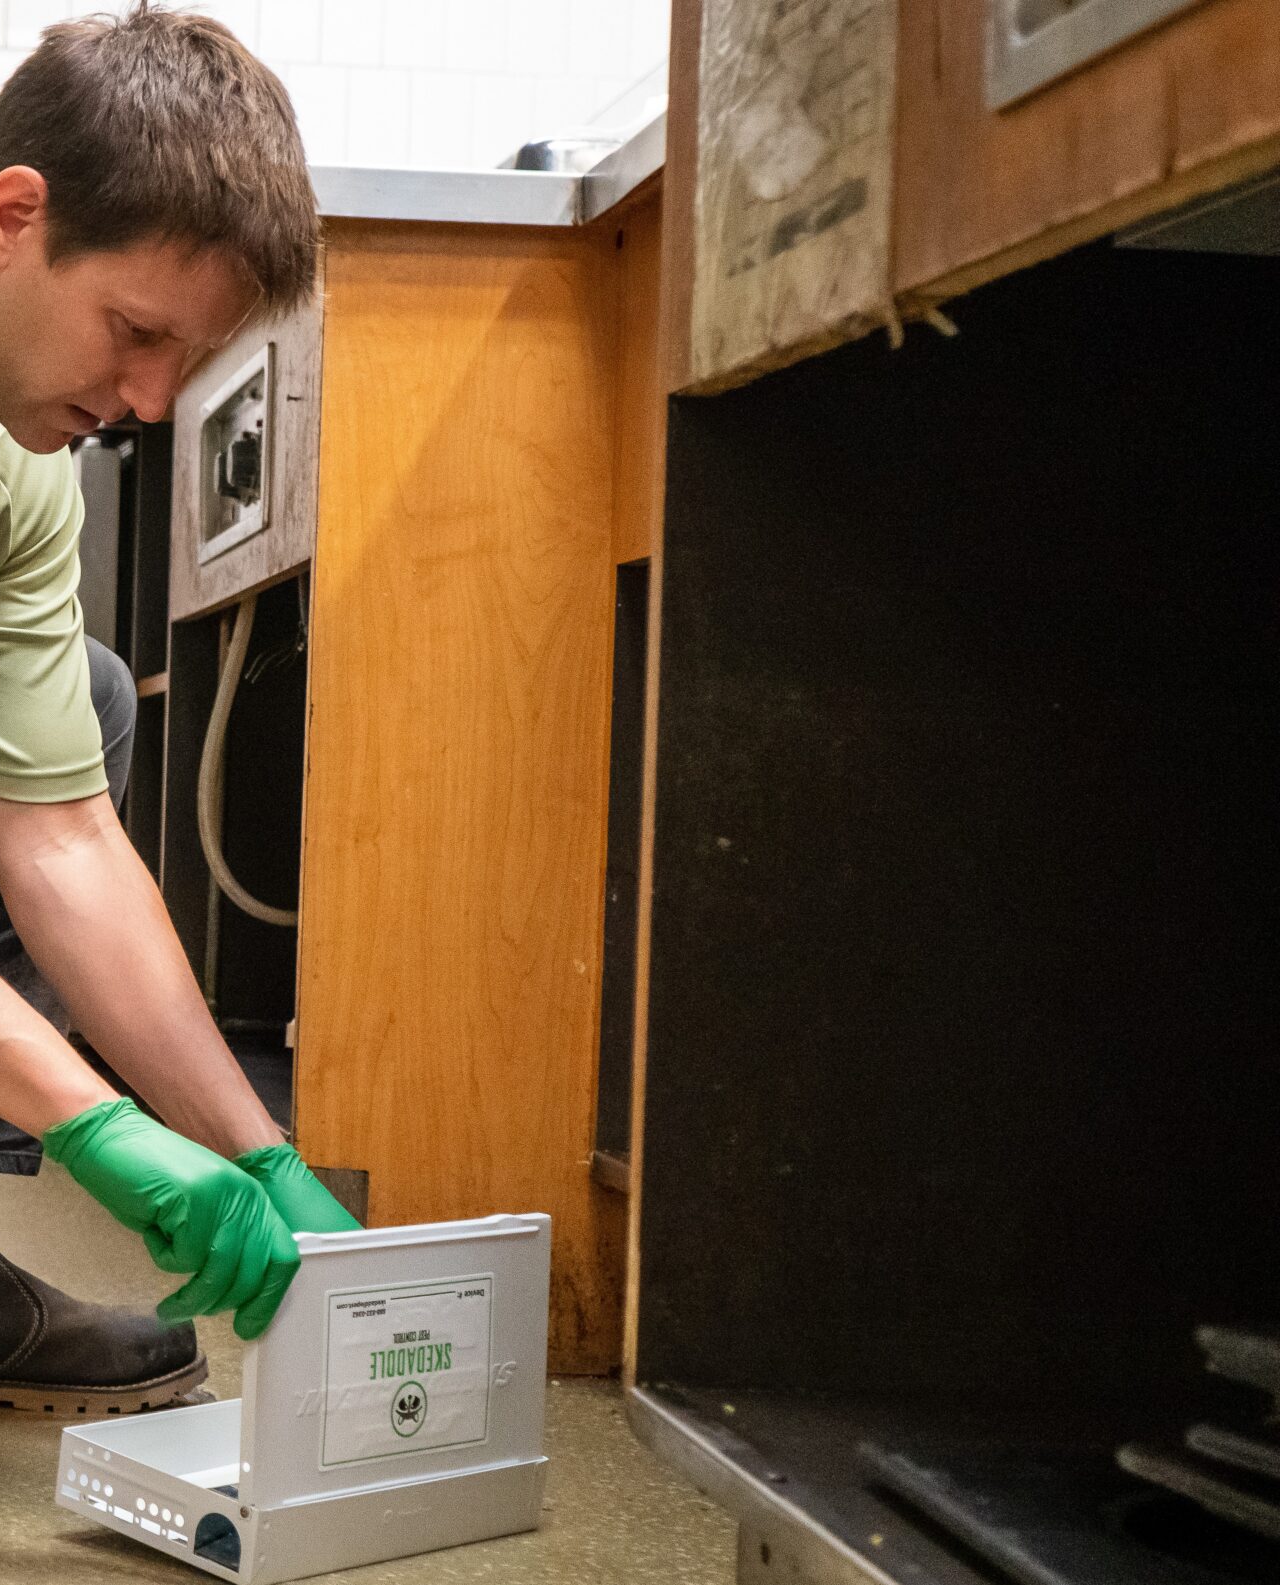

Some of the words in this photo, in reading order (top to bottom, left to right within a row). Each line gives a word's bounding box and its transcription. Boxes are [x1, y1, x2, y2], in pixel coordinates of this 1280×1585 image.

[464, 1288, 485, 1298] Device
[393, 1331, 417, 1344] CONTROL
[418, 1329, 431, 1341] PEST
[370, 1342, 452, 1380] SKEDADDLE
